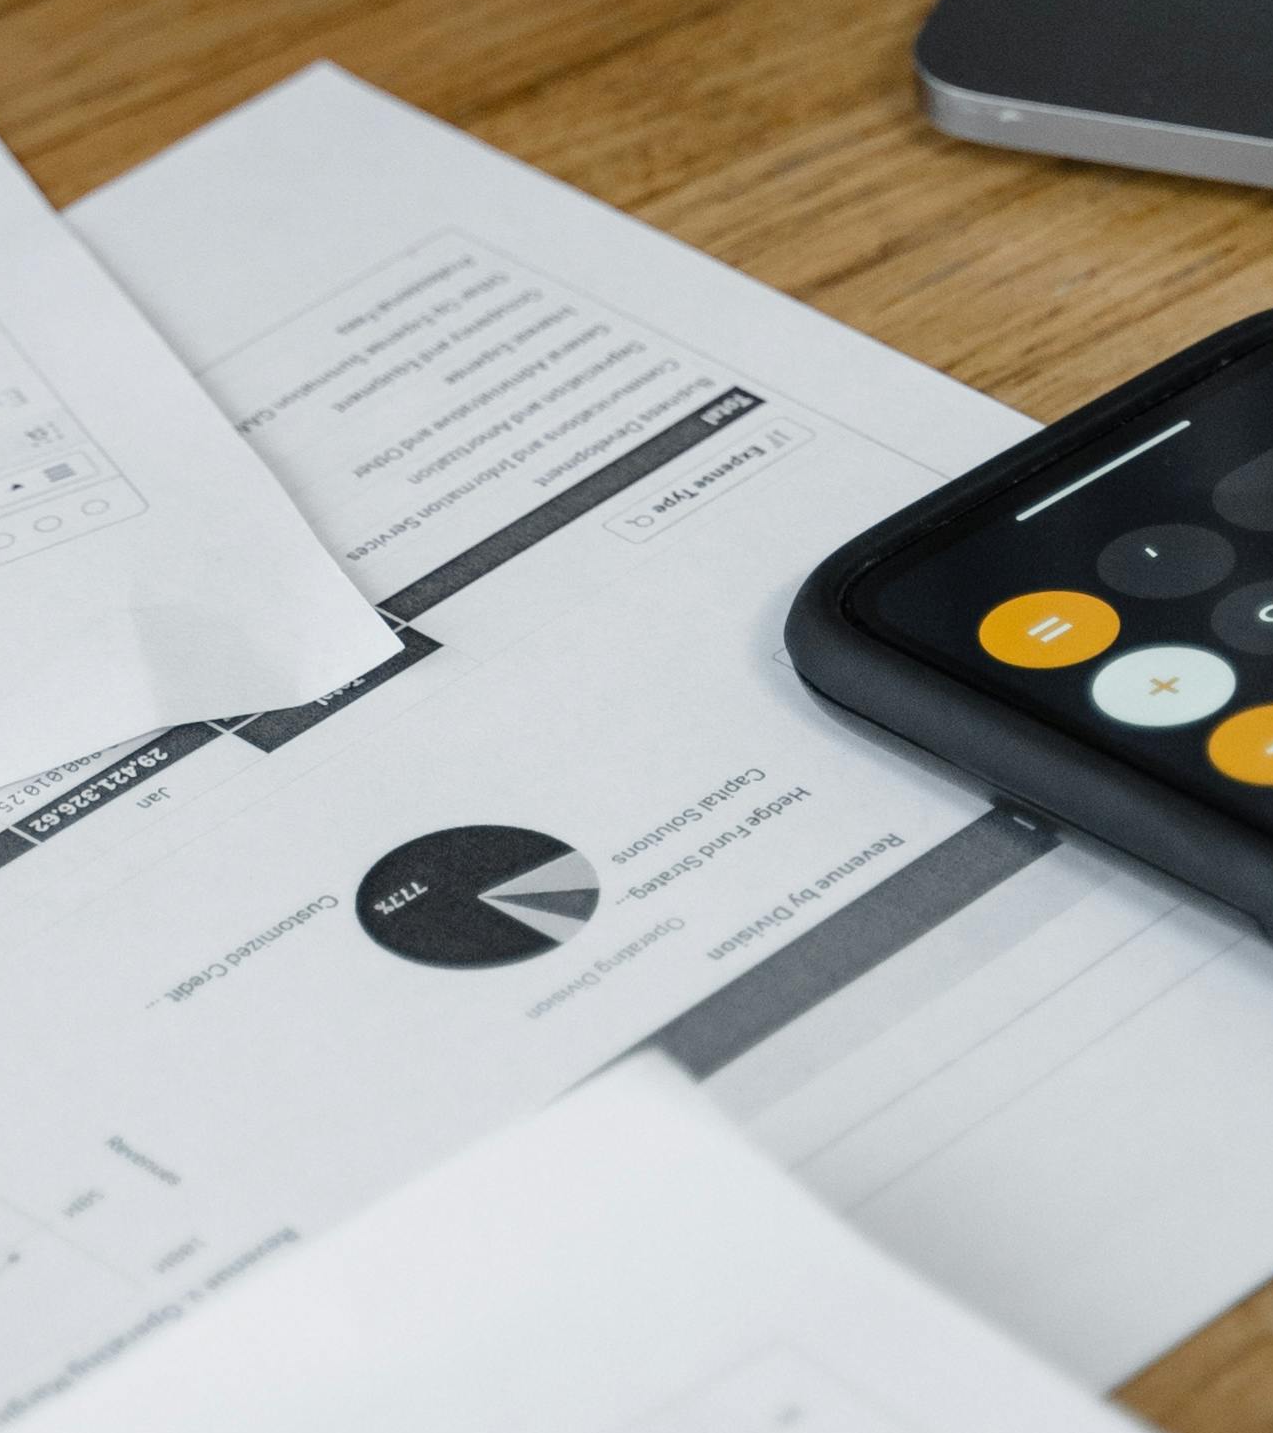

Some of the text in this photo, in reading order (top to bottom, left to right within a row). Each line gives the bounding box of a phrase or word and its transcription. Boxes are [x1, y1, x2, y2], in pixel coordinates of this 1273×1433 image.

[700, 385, 753, 426] Total
[352, 447, 405, 479] Other
[398, 427, 433, 452] and
[407, 419, 513, 485] Amortization
[510, 439, 545, 464] and
[533, 420, 645, 488] Development
[416, 458, 517, 519] Information
[652, 445, 767, 514] Expense Type
[342, 516, 422, 571] Services
[28, 747, 168, 833] 29,421,326.62
[135, 786, 171, 809] Jan
[611, 767, 767, 865] Capital Solutions
[616, 786, 812, 905] Hedge Fund Strateg...
[374, 881, 428, 915] 77.7%
[706, 832, 906, 961] Revenue by Division
[224, 894, 340, 967] Customized
[164, 963, 228, 1003] Credit
[525, 917, 686, 1019] Operating Division
